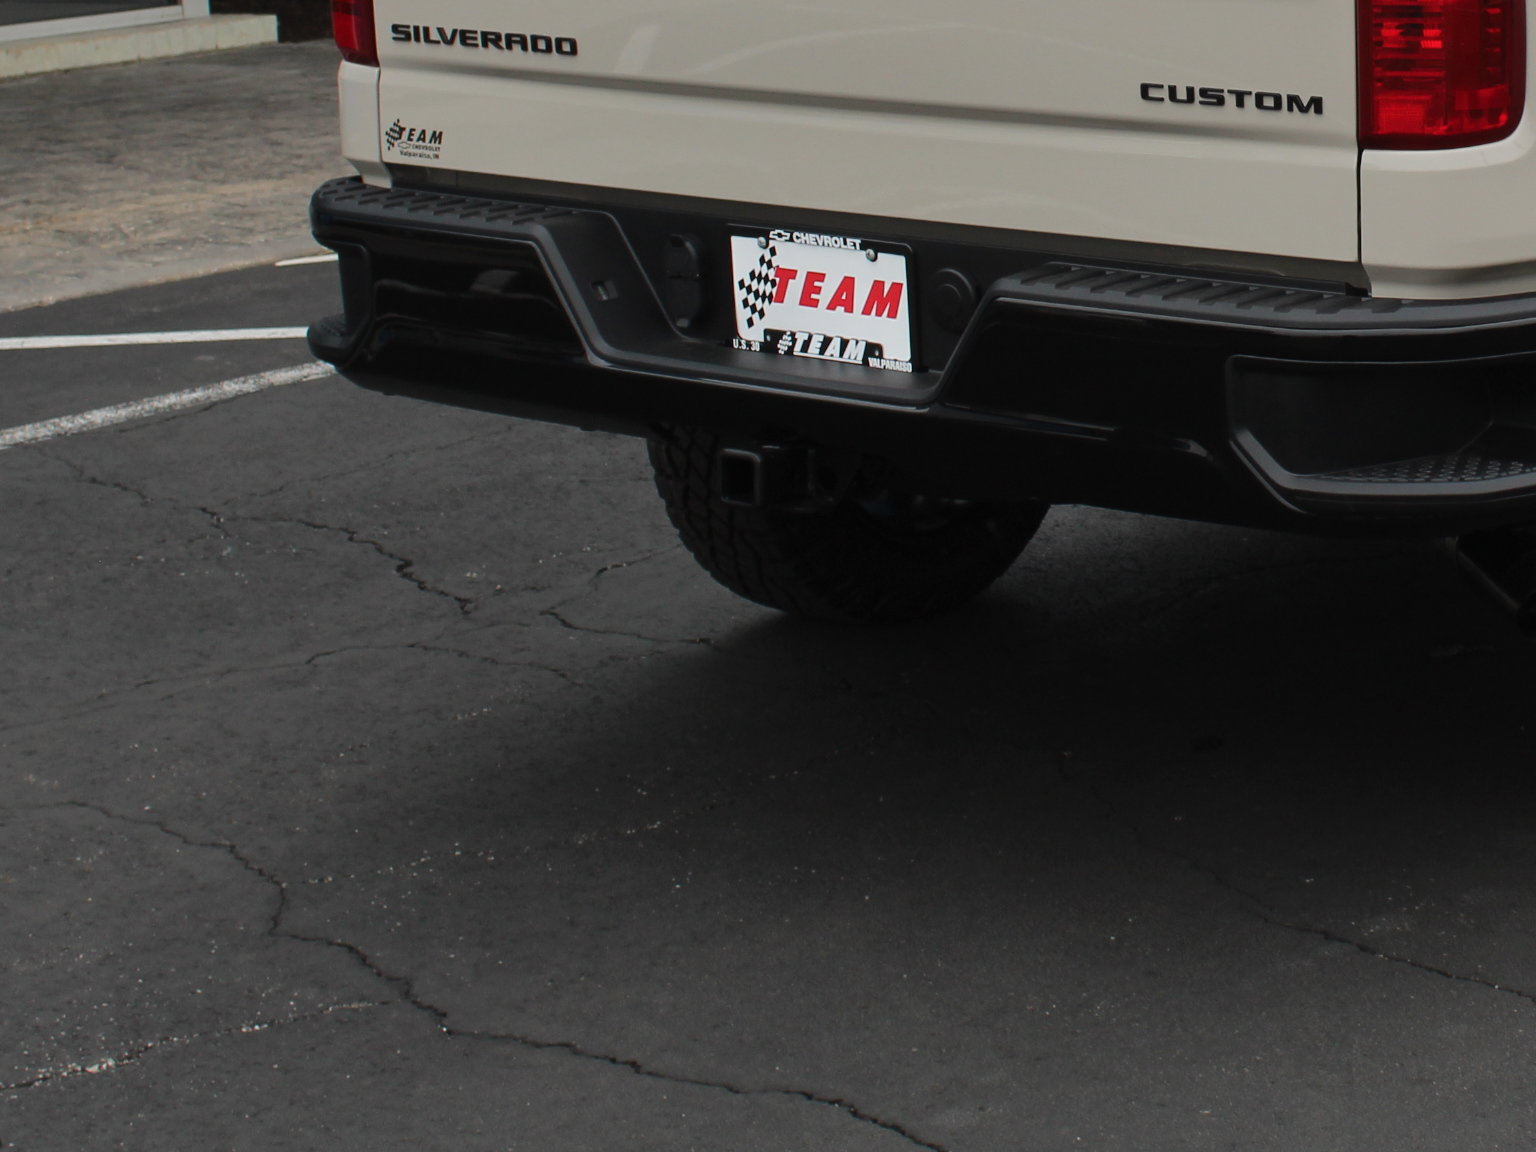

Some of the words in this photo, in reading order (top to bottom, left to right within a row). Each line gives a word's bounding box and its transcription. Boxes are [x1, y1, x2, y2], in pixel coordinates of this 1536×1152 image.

[390, 22, 579, 57] SILVERADO
[1138, 82, 1324, 116] CUSTOM
[399, 126, 443, 145] TEAM
[792, 232, 862, 251] CHEVROLET
[773, 267, 903, 319] TEAM
[733, 339, 750, 350] U.S.
[751, 340, 760, 352] 30
[793, 332, 867, 361] TEAM
[868, 357, 913, 373] VALPARAISO
